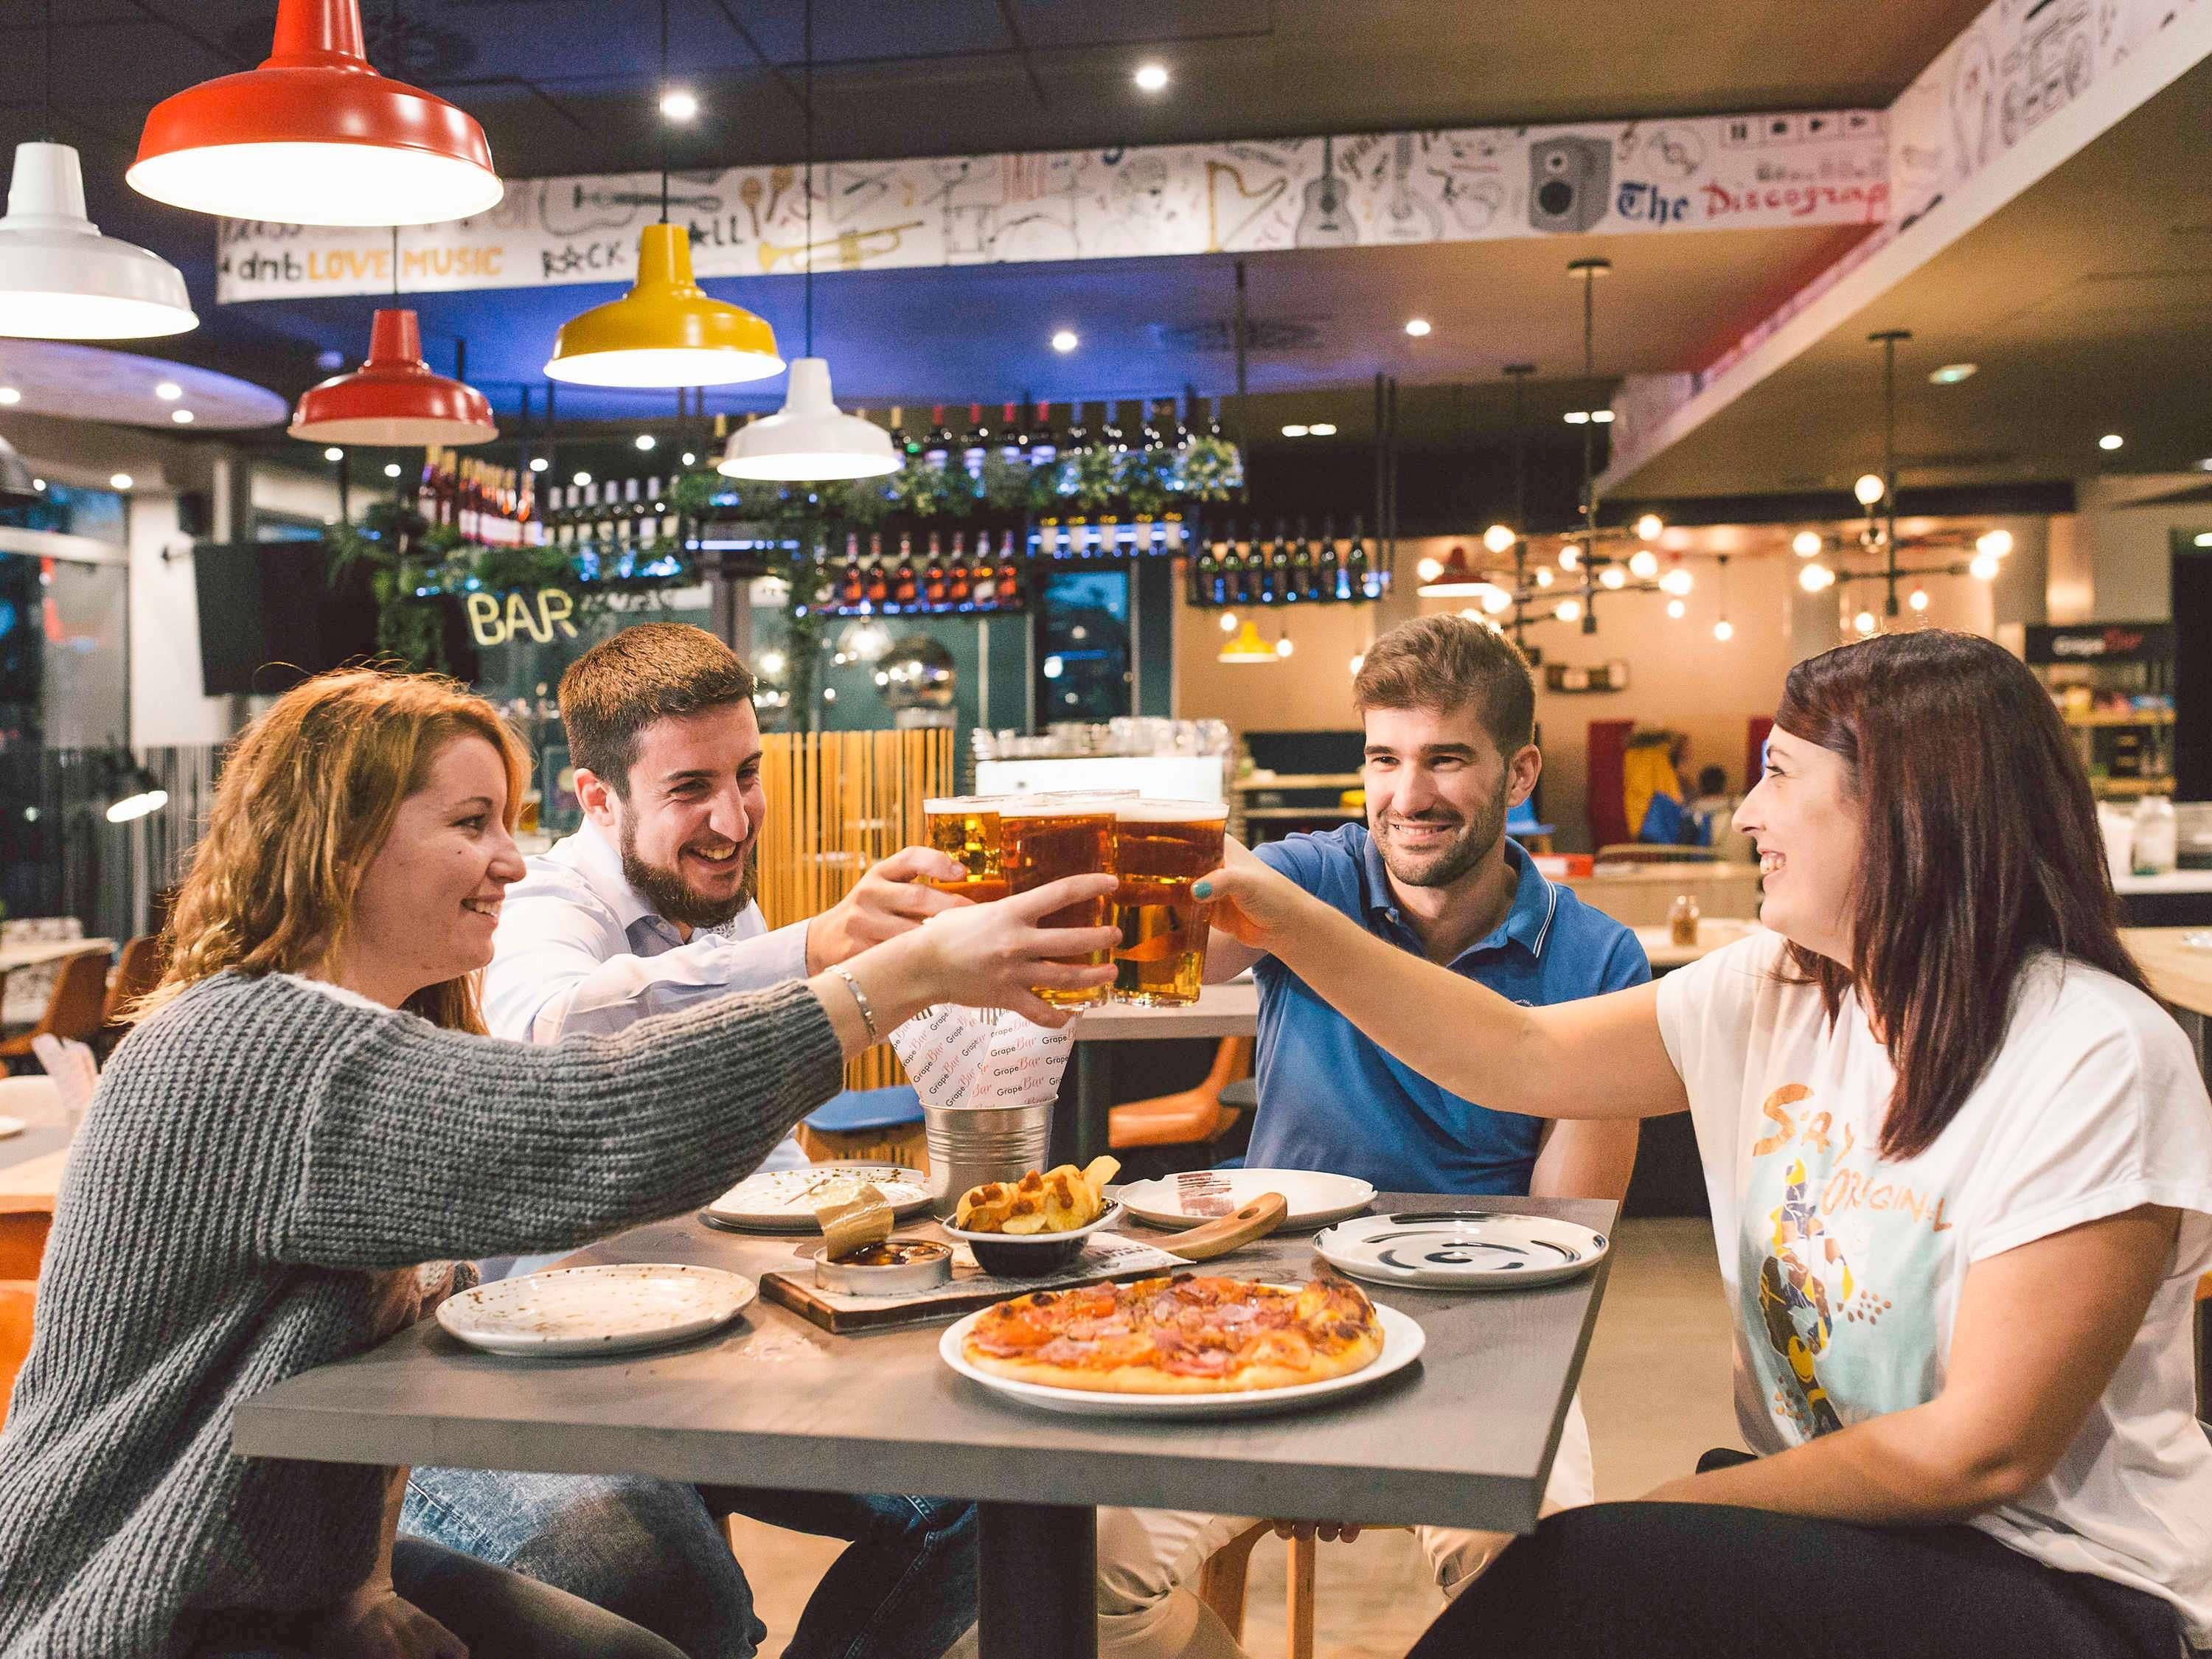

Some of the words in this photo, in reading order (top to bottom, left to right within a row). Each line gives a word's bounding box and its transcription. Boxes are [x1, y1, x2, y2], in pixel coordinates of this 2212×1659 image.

[308, 249, 391, 280] LOVE
[403, 246, 504, 277] MUSIC
[467, 588, 579, 646] BAR
[931, 1012, 949, 1031] Grape
[946, 1026, 964, 1043] Grape
[961, 1039, 978, 1057] Grape
[991, 1046, 1016, 1057] Grape
[1015, 1037, 1037, 1050] Bar
[1042, 1034, 1067, 1045] Grape
[902, 1050, 917, 1067] rape
[993, 1065, 1019, 1077] Grape
[1018, 1057, 1040, 1070] Bar
[914, 1060, 933, 1082] Grape
[929, 1073, 949, 1094] Grape
[996, 1085, 1023, 1096] Grape
[1022, 1076, 1045, 1091] Bar
[1049, 1077, 1062, 1085] Gra
[945, 1085, 966, 1107] Grape
